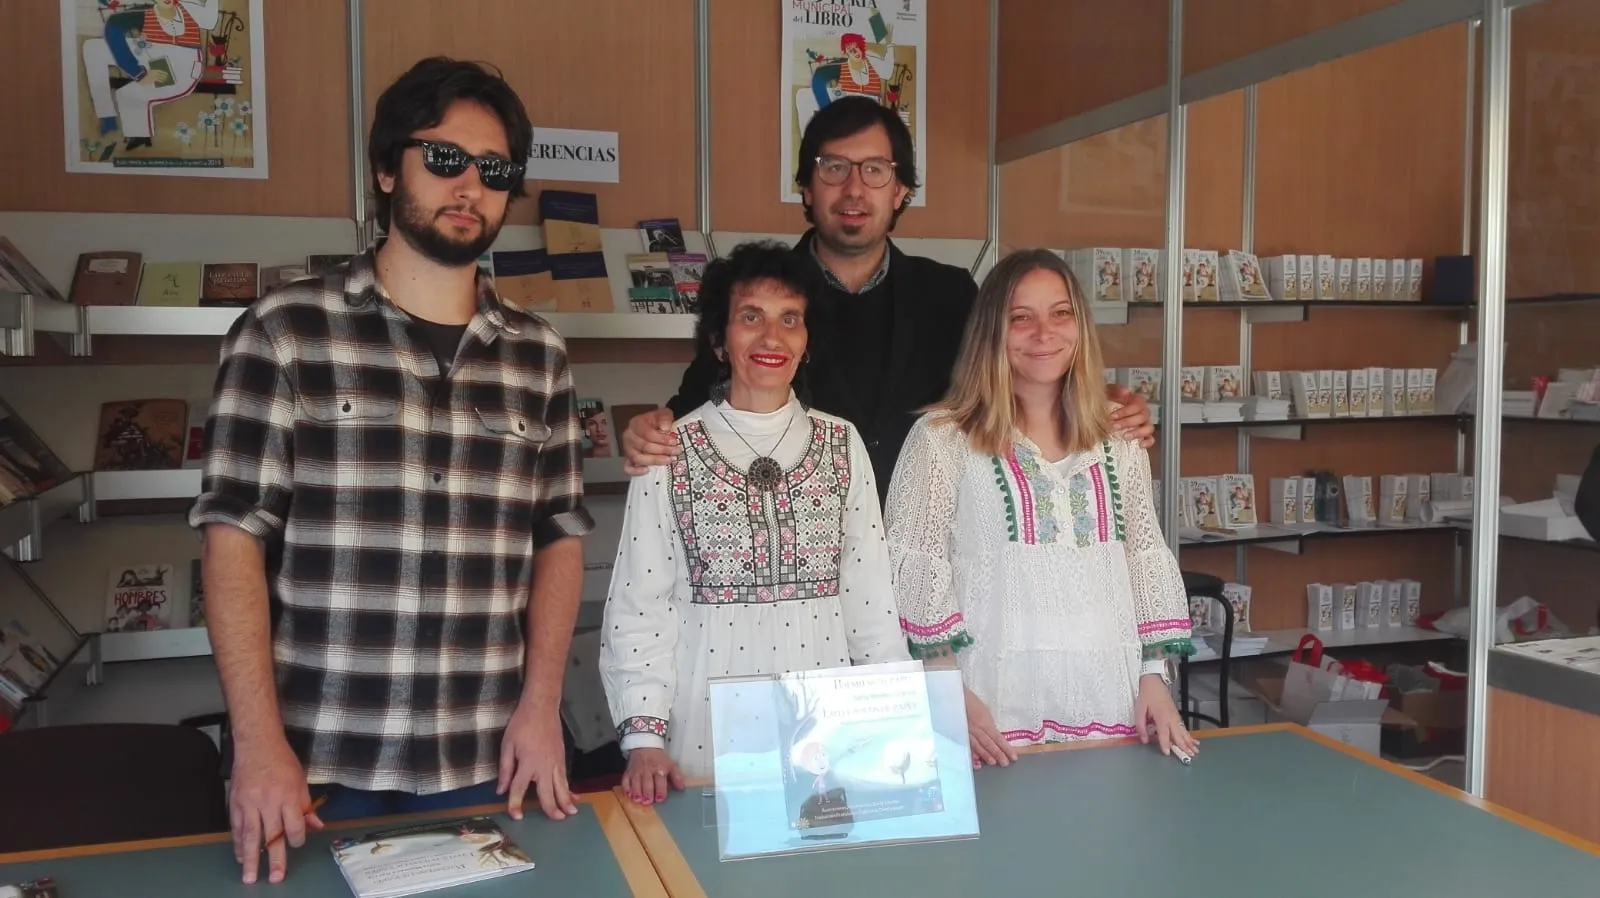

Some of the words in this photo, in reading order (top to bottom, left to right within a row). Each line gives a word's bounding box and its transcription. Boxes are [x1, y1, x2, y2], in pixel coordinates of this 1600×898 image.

[792, 1, 854, 15] MUNICIPAL
[805, 10, 853, 27] LIBRO
[528, 144, 616, 162] ERENCIAS
[114, 591, 166, 605] HOMBRES
